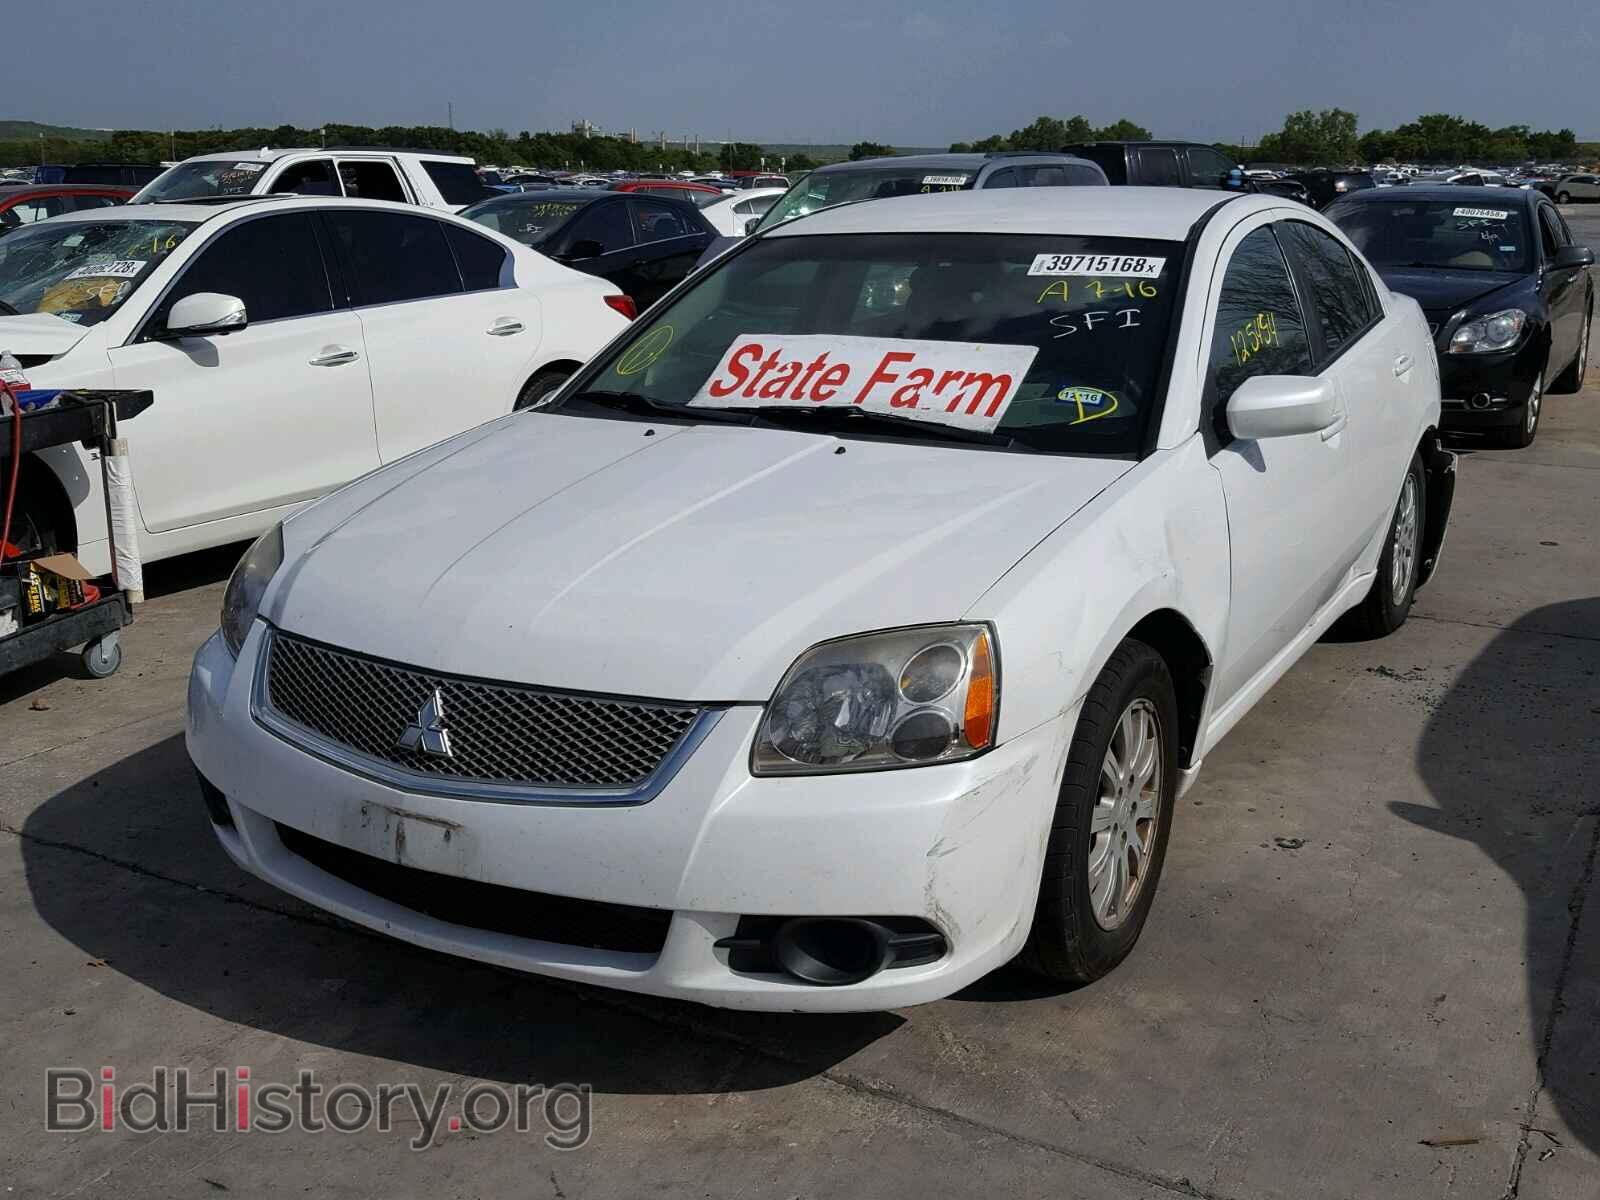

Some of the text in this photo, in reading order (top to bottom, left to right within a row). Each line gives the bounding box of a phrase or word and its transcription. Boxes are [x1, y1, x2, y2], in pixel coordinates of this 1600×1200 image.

[1037, 280, 1069, 304] A
[709, 343, 851, 402] State
[853, 351, 1012, 418] Farm
